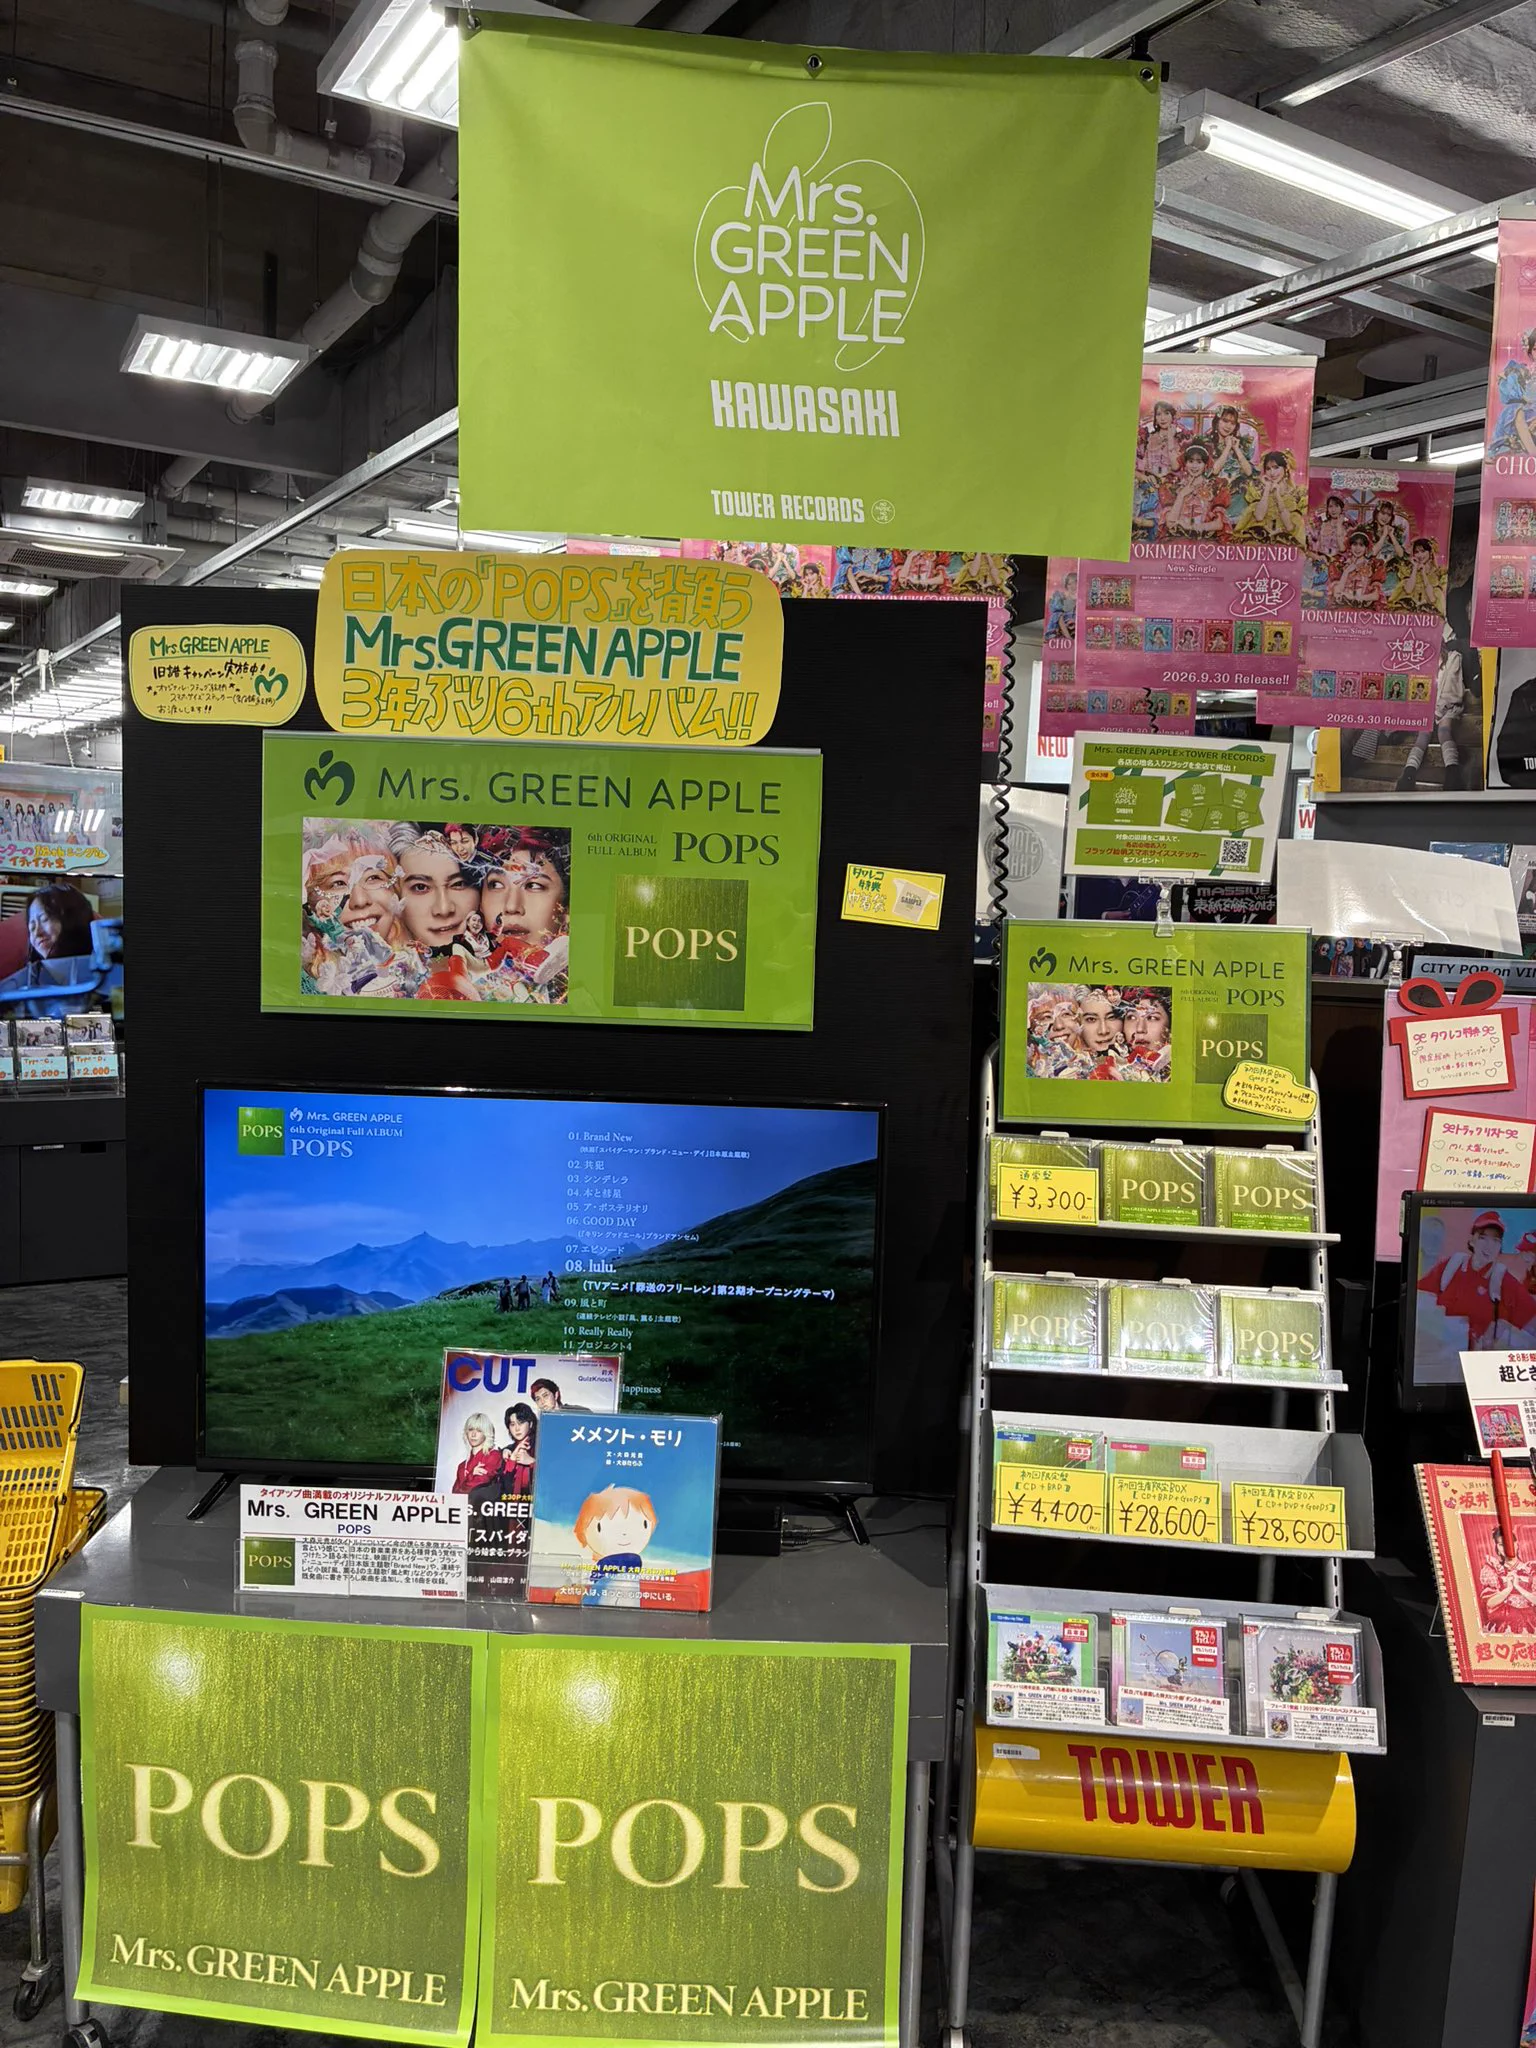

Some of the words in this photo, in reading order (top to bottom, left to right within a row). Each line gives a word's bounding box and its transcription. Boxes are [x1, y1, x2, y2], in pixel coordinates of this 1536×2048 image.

[744, 162, 877, 226] Mrs.
[710, 221, 909, 284] GREEN
[709, 281, 907, 344] APPLE
[710, 380, 900, 437] KAWASAKI
[1495, 455, 1536, 476] CHO
[710, 490, 776, 519] TOWER
[781, 494, 865, 523] RECORDS
[1216, 545, 1298, 562] SENDENBU
[1167, 564, 1186, 572] New
[1188, 564, 1217, 574] Single
[341, 554, 753, 630] 日本の『POPS』を背負う
[1240, 578, 1282, 593] 大盛り
[1300, 609, 1357, 624] TOKIMEKI
[1372, 614, 1440, 628] SENDENBU
[1350, 627, 1373, 636] Single
[179, 636, 229, 654] GREEN
[229, 637, 271, 653] APPLE
[1392, 640, 1425, 652] 大盛り
[602, 627, 744, 682] APPLE
[1162, 671, 1230, 683] 2026.9.30
[1234, 672, 1290, 685] Release!!
[1326, 713, 1381, 724] 2026.9.30
[1384, 716, 1428, 727] Release!!
[1094, 745, 1112, 754] Mrs.
[1115, 747, 1147, 755] GREEN
[1220, 752, 1267, 763] RECORDS
[378, 767, 471, 803] Mrs.
[488, 771, 632, 809] GREEN
[647, 778, 782, 815] APPLE
[587, 832, 603, 842] 6th
[604, 833, 658, 845] ORIGINAL
[587, 845, 616, 856] FULL
[617, 846, 657, 858] ALBUM
[672, 831, 780, 866] POPS
[624, 926, 739, 962] POPS
[1068, 955, 1119, 974] Mrs.
[1127, 957, 1205, 977] GREEN
[1212, 960, 1285, 980] APPLE
[1420, 962, 1456, 974] CITY
[1492, 967, 1511, 978] on
[1227, 988, 1285, 1008] POPS
[1201, 1039, 1264, 1059] POPS
[306, 1111, 331, 1122] Mrs.
[332, 1112, 368, 1123] GREEN
[370, 1113, 403, 1125] APPLE
[242, 1124, 283, 1140] POPS
[289, 1125, 306, 1136] 6th
[306, 1126, 345, 1137] Original
[347, 1127, 365, 1137] Full
[366, 1127, 404, 1138] ALBUM
[568, 1131, 582, 1142] 01.
[583, 1132, 611, 1142] Brand
[612, 1132, 634, 1143] New
[290, 1138, 353, 1159] POPS
[567, 1160, 582, 1170] 02.
[584, 1160, 605, 1171] 共犯
[567, 1174, 582, 1184] 03.
[583, 1174, 629, 1185] シンデレラ
[567, 1188, 582, 1198] 04.
[1009, 1183, 1093, 1211] ¥3,300-
[1122, 1178, 1196, 1204] POPS
[1233, 1184, 1307, 1210] POPS
[583, 1203, 649, 1214] ア・ポステリオリ
[566, 1216, 581, 1226] 06.
[582, 1216, 614, 1226] GOOD
[616, 1217, 637, 1227] DAY
[565, 1244, 579, 1254] 07.
[581, 1245, 625, 1256] エピソード
[565, 1260, 586, 1273] 08.
[588, 1259, 617, 1273] lulu.
[564, 1298, 579, 1308] 09.
[580, 1298, 608, 1309] 風と町
[563, 1326, 577, 1336] 10.
[578, 1327, 605, 1339] Really
[607, 1328, 634, 1339] Really
[1012, 1313, 1088, 1338] POPS
[577, 1341, 632, 1352] プロジェクト4
[1239, 1328, 1317, 1355] POPS
[448, 1357, 537, 1394] CUT
[570, 1426, 682, 1448] メメント・モリ
[1019, 1469, 1069, 1481] 初回限定盤
[260, 1487, 446, 1505] タイアップ曲満載のオリジナルフルアルバム!
[247, 1500, 291, 1519] Mrs.
[304, 1502, 378, 1521] GREEN
[391, 1505, 462, 1525] APPLE
[1007, 1490, 1102, 1525] ¥4,400-
[1118, 1500, 1216, 1538] ¥28,600-
[1240, 1509, 1343, 1545] ¥28,600-
[337, 1524, 372, 1535] POPS
[248, 1553, 293, 1569] POPS
[603, 1564, 626, 1573] APPLE
[1247, 1682, 1257, 1695] 5
[1067, 1743, 1266, 1836] TOWER
[125, 1762, 441, 1880] POPS
[528, 1795, 860, 1893] POPS
[110, 1933, 182, 1973] Mrs.
[187, 1943, 322, 1991] GREEN
[325, 1964, 448, 2007] APPLE
[508, 1977, 590, 2013] Mrs.
[593, 1980, 738, 2017] GREEN
[740, 1985, 869, 2022] APPLE
